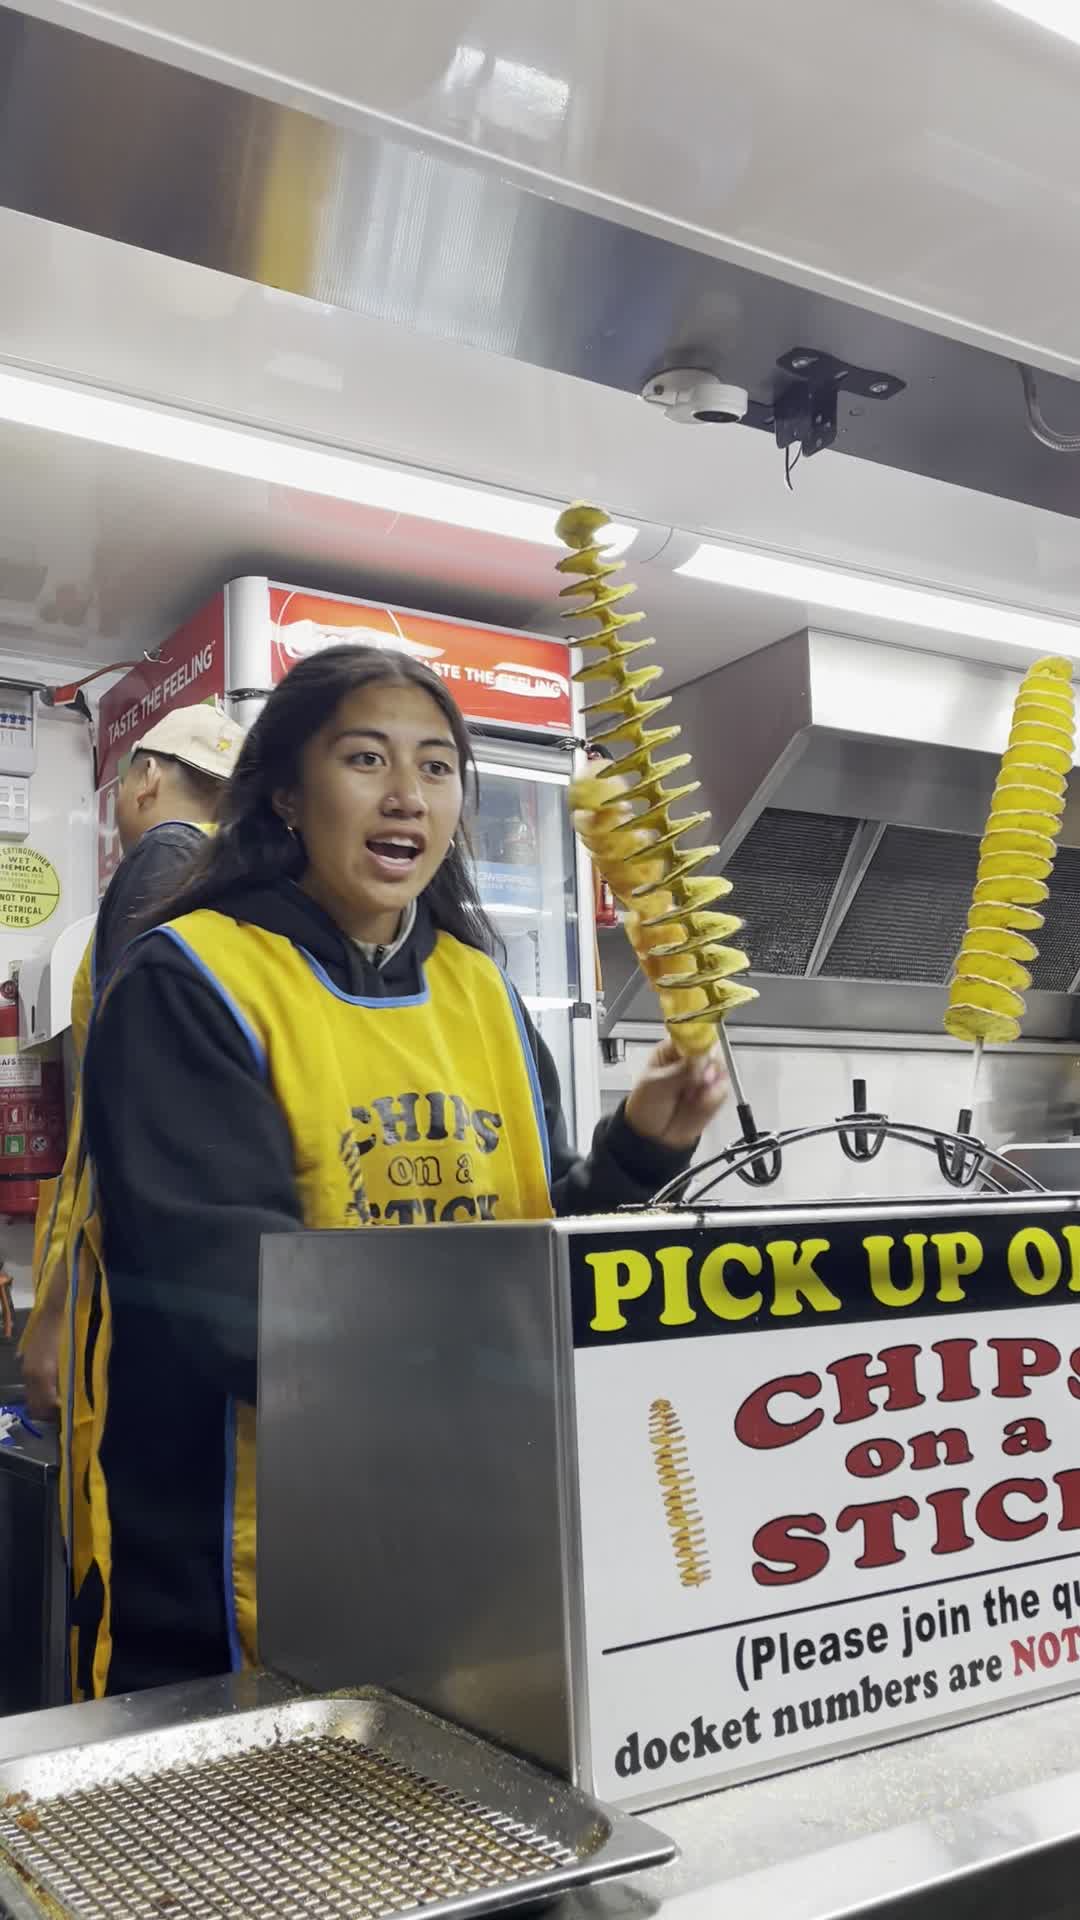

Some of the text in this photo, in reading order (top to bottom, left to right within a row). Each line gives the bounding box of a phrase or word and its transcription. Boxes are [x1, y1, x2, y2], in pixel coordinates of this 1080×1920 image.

[464, 667, 495, 685] THE
[108, 643, 213, 745] TASTE THE FEELING
[0, 864, 43, 873] HEMICAL
[8, 856, 30, 865] WET
[0, 893, 36, 904] NOT FOR
[6, 915, 30, 925] FIRES
[388, 1153, 473, 1186] on a
[584, 1238, 842, 1331] PICK
[862, 1231, 983, 1307] UP
[845, 1417, 1052, 1478] on a
[735, 1622, 889, 1692] (Please
[902, 1598, 971, 1658] join
[983, 1586, 1040, 1628] the
[614, 1625, 1080, 1778] docket numbers are NOT
